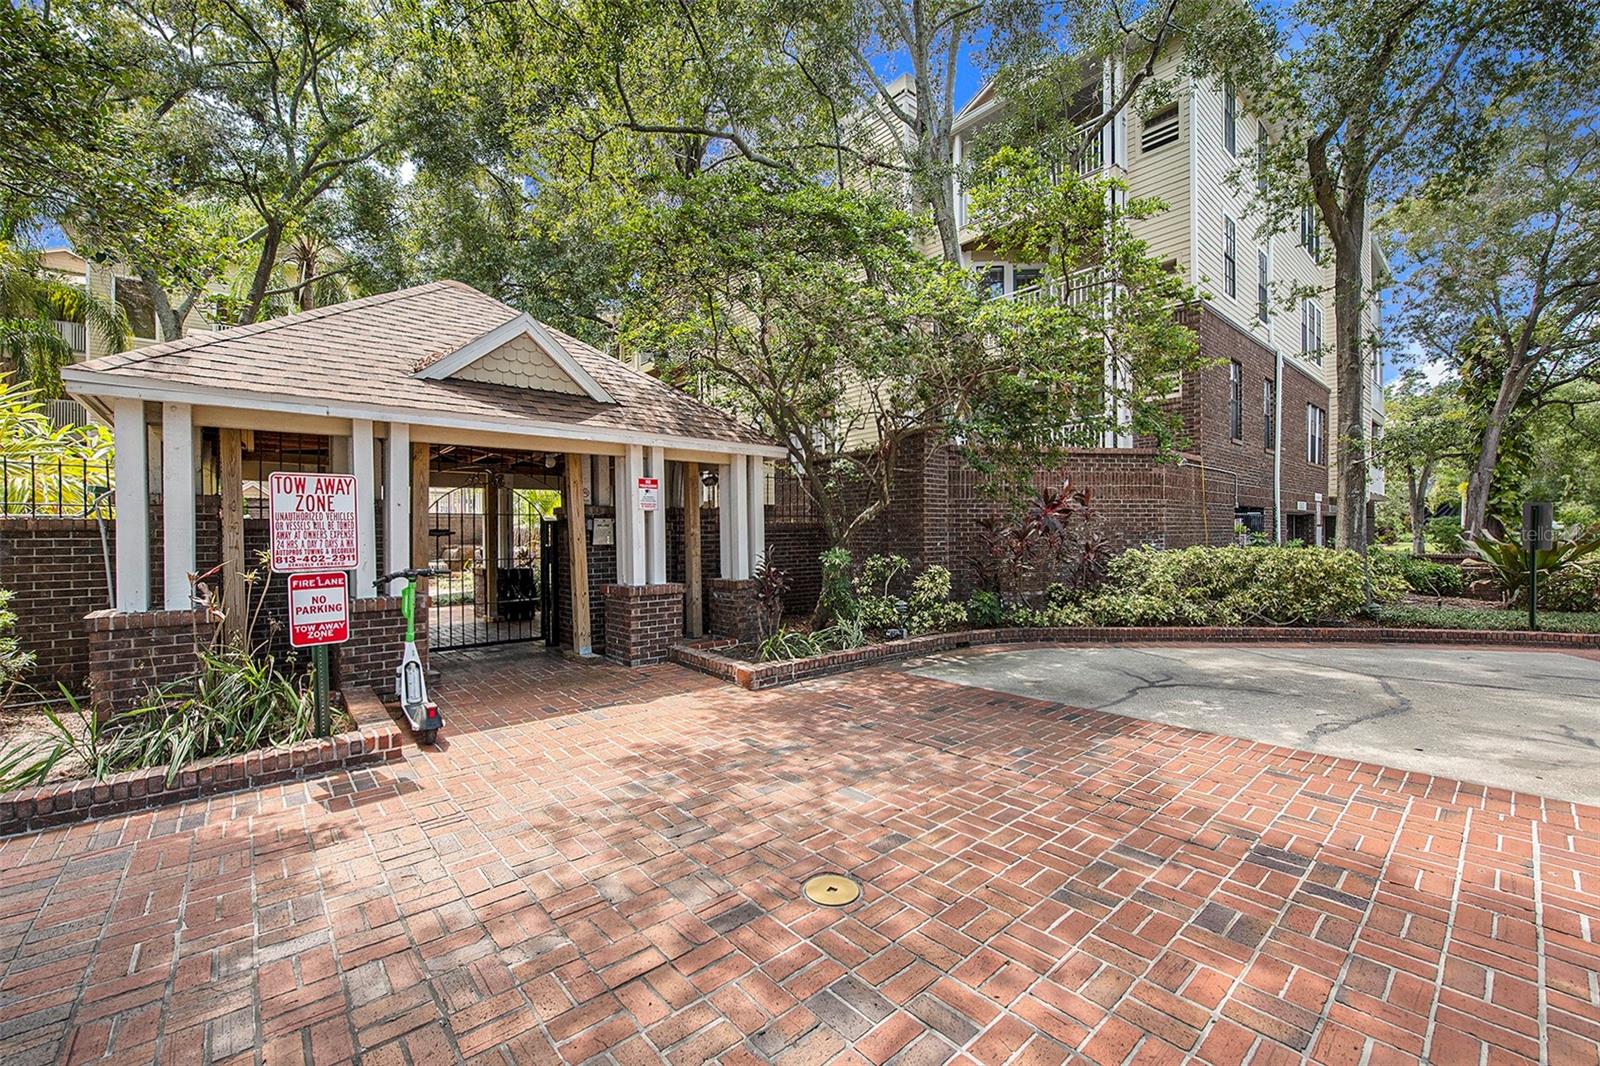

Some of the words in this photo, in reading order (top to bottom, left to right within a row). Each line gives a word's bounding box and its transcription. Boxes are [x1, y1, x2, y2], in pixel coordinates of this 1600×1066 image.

[274, 476, 306, 494] TOW
[315, 477, 352, 495] AWAY
[295, 494, 335, 512] ZONE
[275, 512, 323, 521] UNAUTHORIZED
[326, 511, 354, 520] VEHICLES
[275, 521, 283, 530] OR
[286, 521, 311, 530] VESSELS
[276, 530, 292, 540] AWAY
[294, 530, 301, 539] AT
[277, 540, 284, 549] 24
[275, 554, 355, 564] 813-402-2911
[292, 580, 315, 588] FIRE
[318, 578, 344, 586] LANE
[311, 595, 326, 604] NO
[296, 604, 342, 615] PARKING
[294, 625, 316, 633] TOW
[319, 622, 345, 631] AWAY
[307, 630, 334, 639] ZONE
